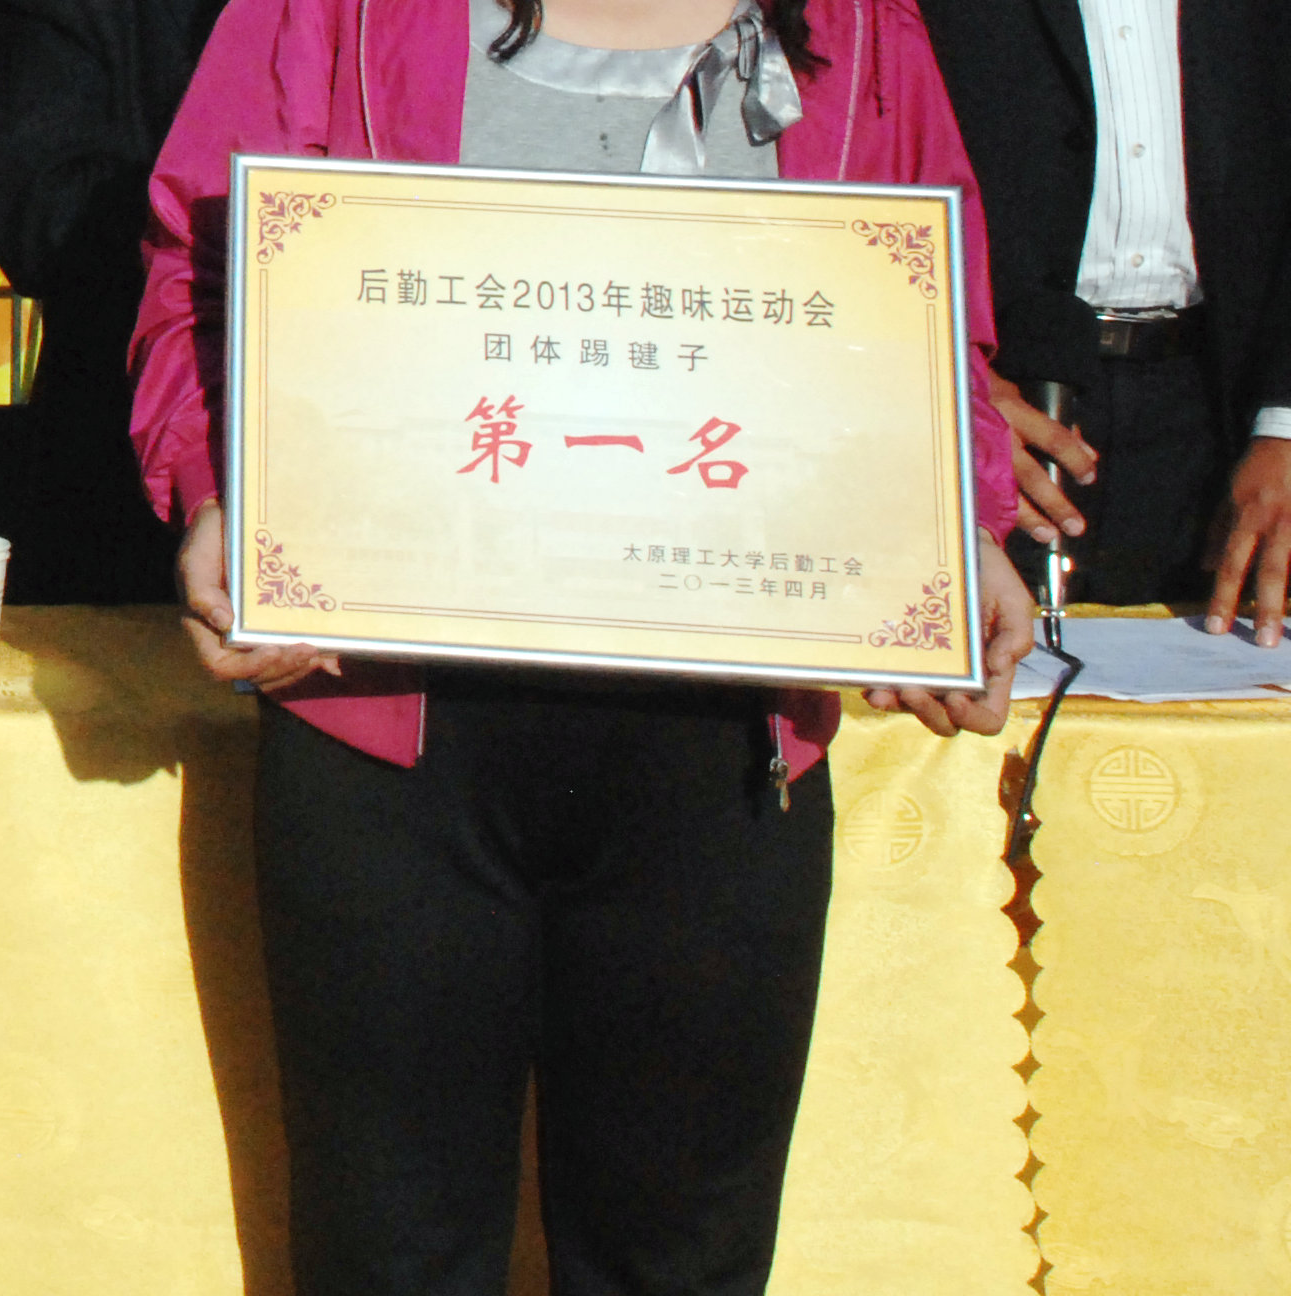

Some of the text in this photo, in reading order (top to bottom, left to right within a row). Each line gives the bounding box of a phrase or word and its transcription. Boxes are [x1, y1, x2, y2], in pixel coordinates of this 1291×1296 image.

[357, 269, 835, 328] 后勤工会2013年趣味运动会
[484, 333, 709, 373] 团体踢毽子
[457, 394, 749, 490] 第一名
[623, 544, 863, 577] 太原理工大学后勤工会
